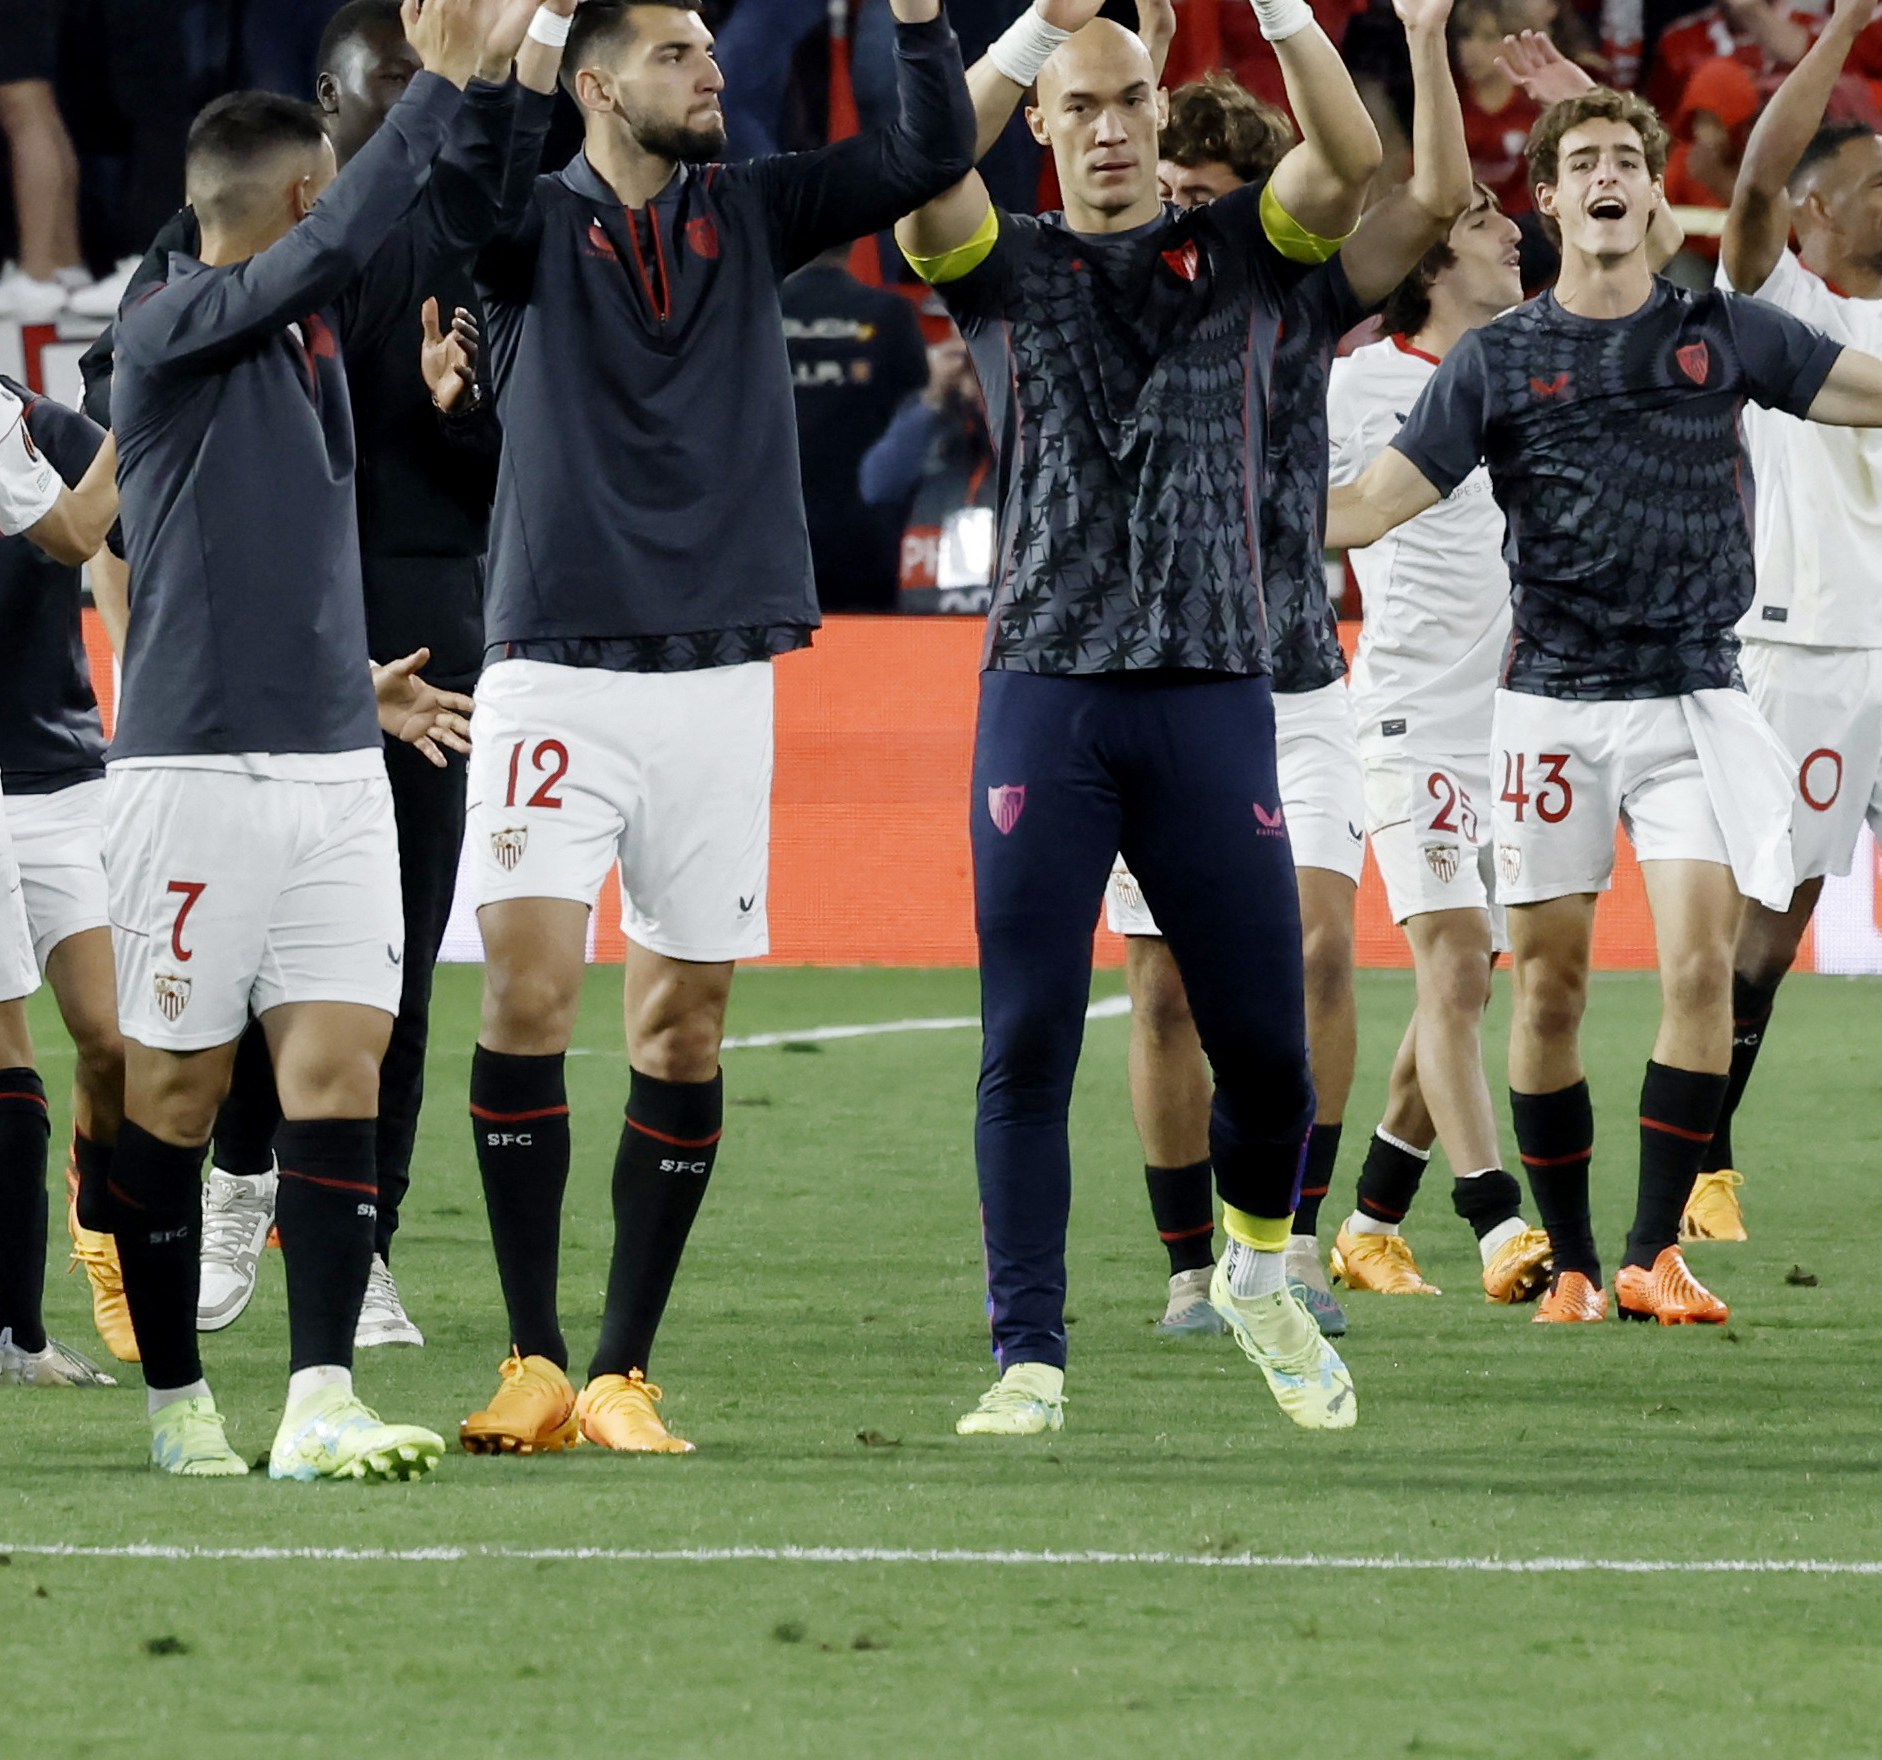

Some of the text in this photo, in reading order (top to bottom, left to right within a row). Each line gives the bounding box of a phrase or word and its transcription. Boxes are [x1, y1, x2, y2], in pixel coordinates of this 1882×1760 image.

[504, 737, 570, 811] 12
[1500, 748, 1573, 824] 43
[164, 879, 208, 963] 7
[487, 1133, 533, 1147] SFC
[659, 1158, 707, 1174] SFC
